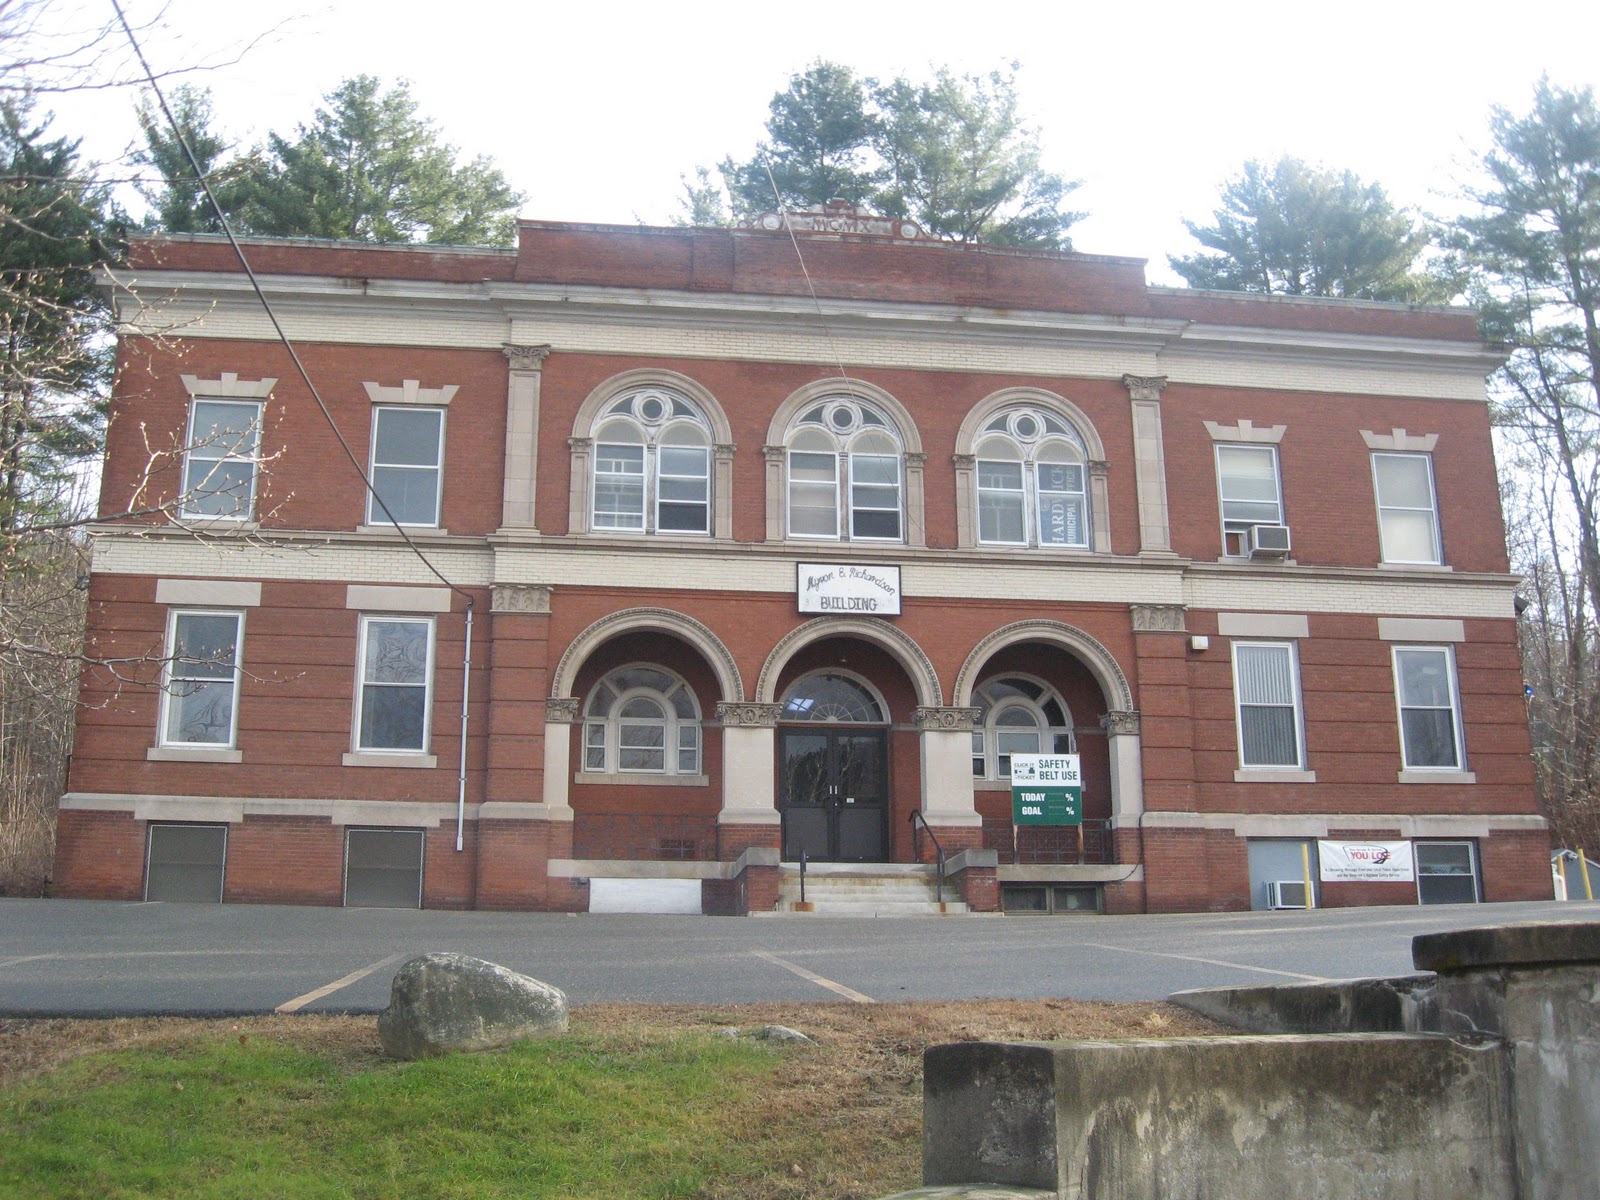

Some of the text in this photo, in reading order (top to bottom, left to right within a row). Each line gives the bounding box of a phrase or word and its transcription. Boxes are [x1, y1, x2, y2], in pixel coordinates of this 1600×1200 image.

[812, 218, 871, 233] MCMX
[806, 572, 835, 592] Myron
[849, 567, 896, 596] Richardson
[820, 596, 878, 611] BUILDING
[1038, 759, 1071, 769] SAFETY
[1039, 771, 1077, 780] BELT USE
[1020, 793, 1074, 802] TODAY %
[1022, 806, 1075, 815] GOAL %
[1350, 852, 1368, 860] YOU
